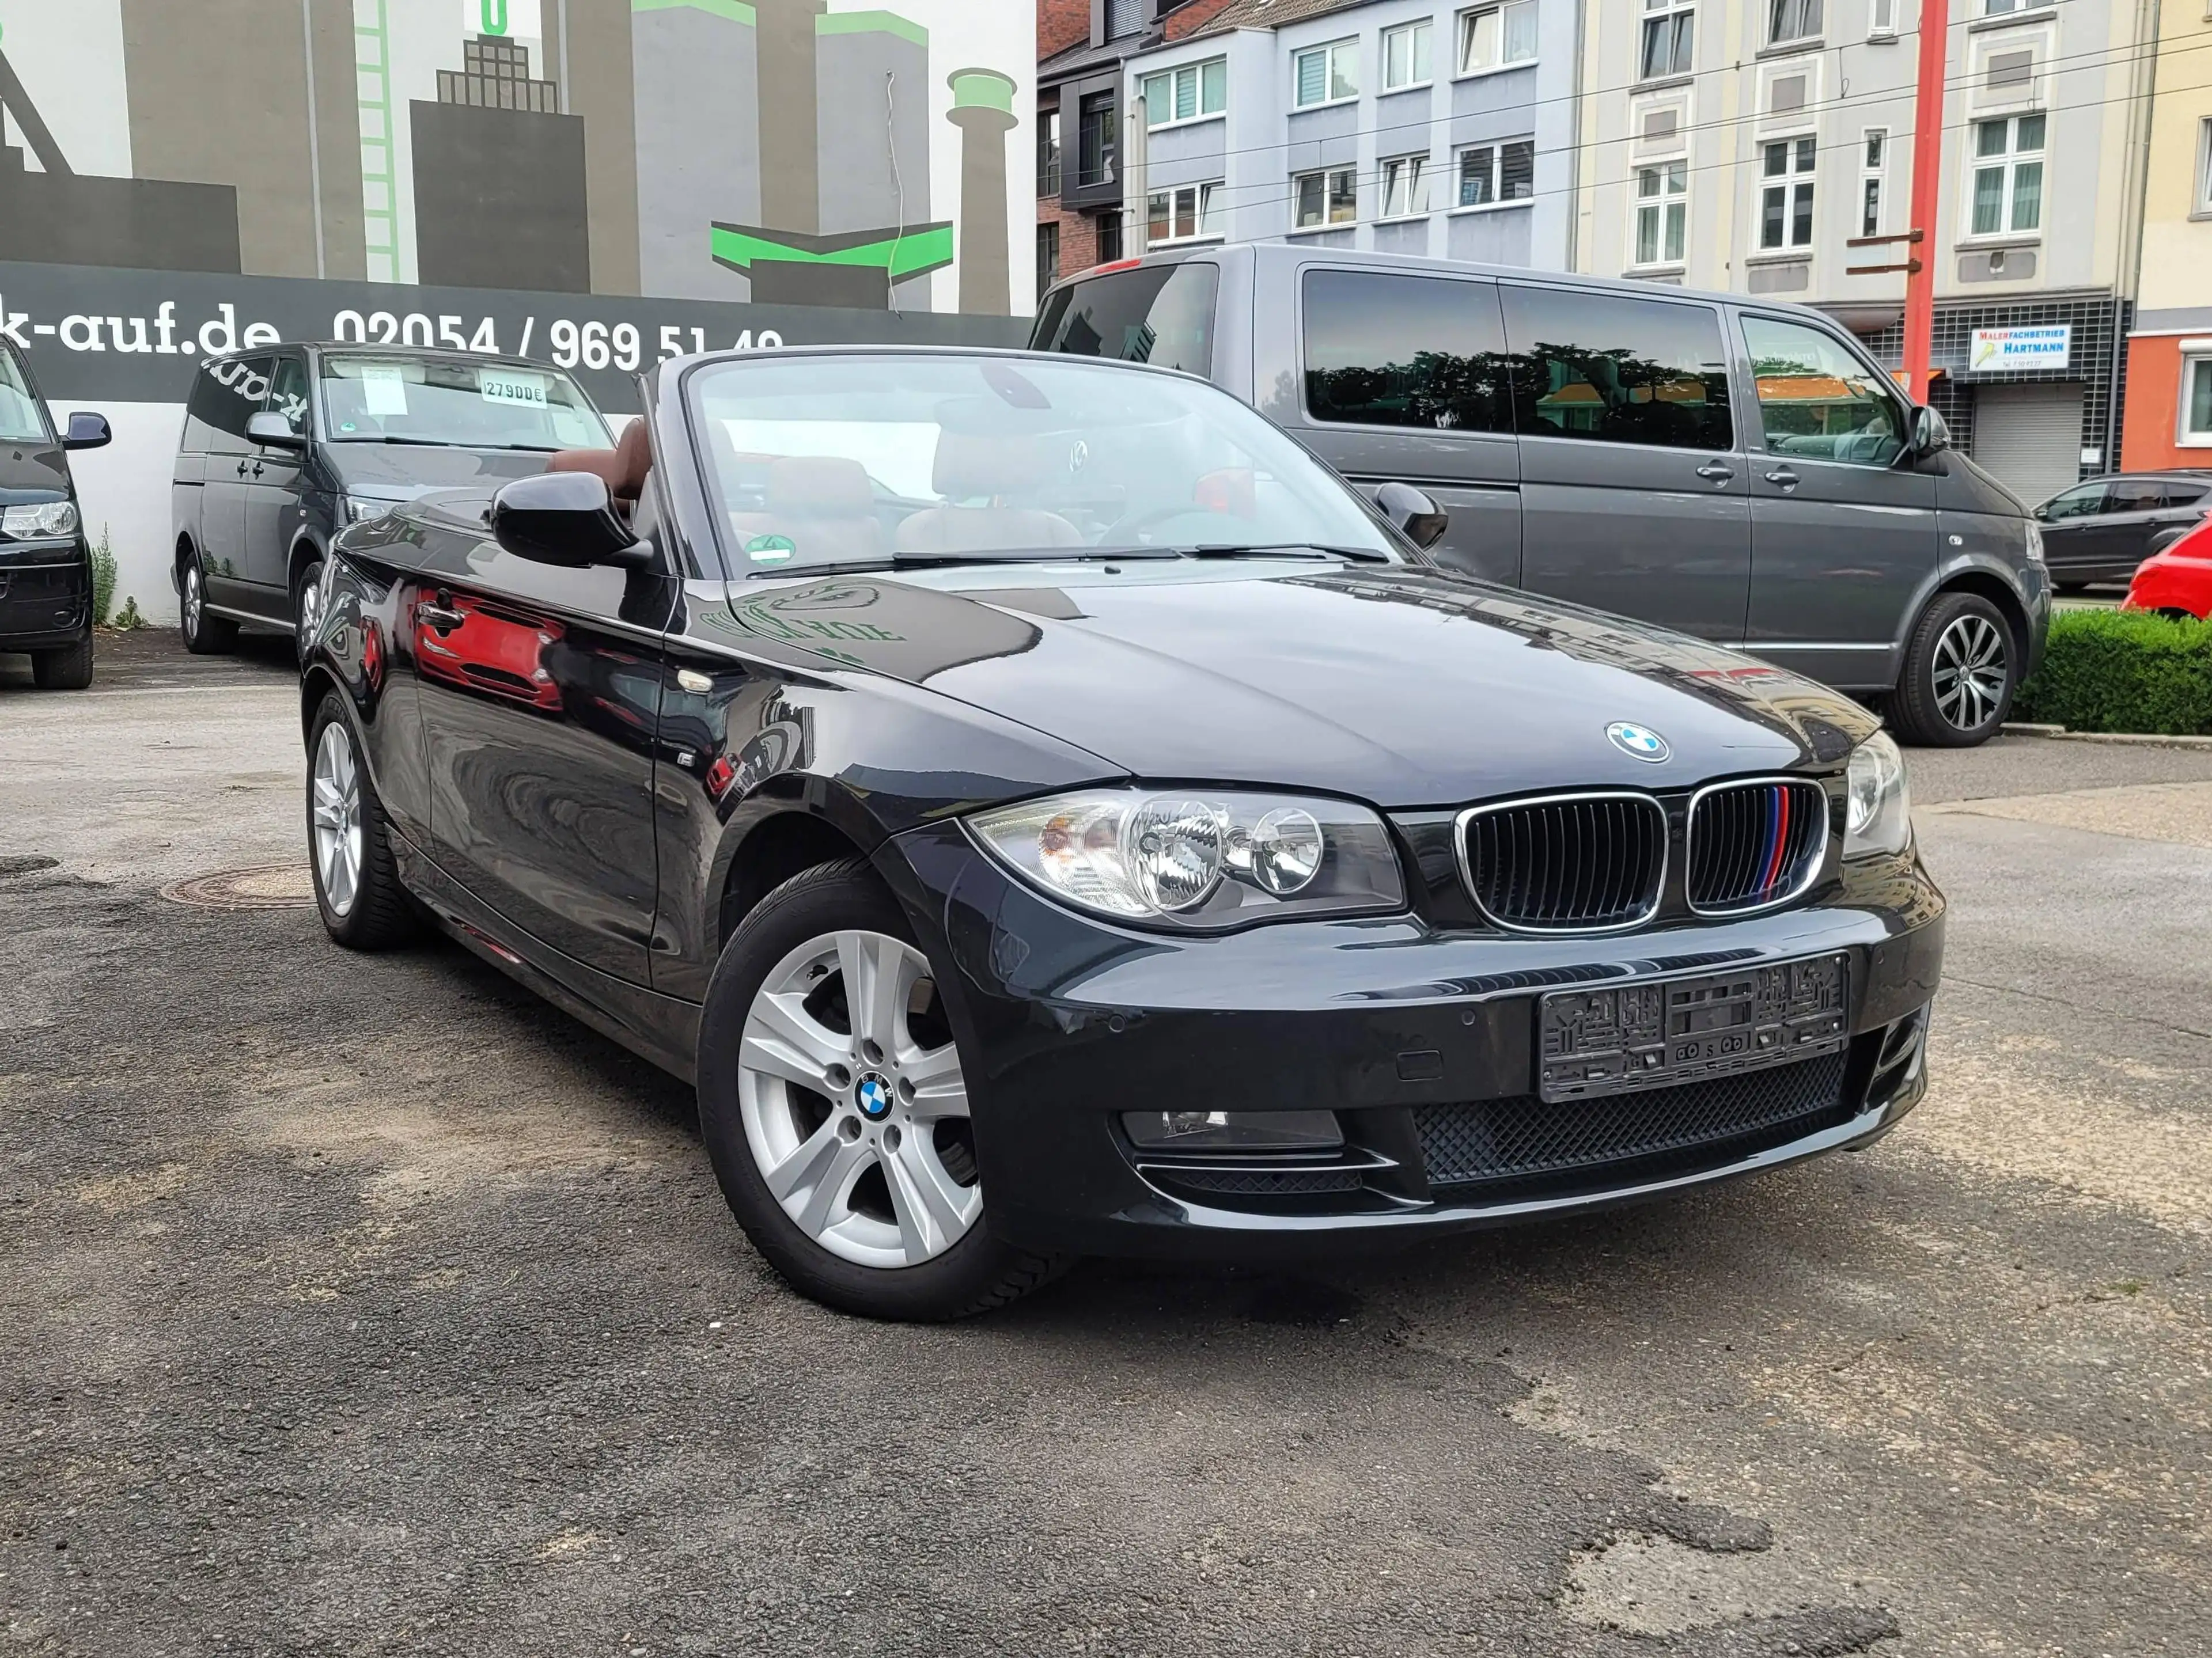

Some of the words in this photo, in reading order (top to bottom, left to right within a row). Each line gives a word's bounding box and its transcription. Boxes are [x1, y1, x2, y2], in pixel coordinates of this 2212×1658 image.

[334, 309, 499, 354] 02054
[550, 319, 640, 371] 969
[1979, 329, 2065, 340] MALERFACHBETRIEB
[2004, 343, 2064, 354] HARTMANN
[487, 382, 542, 402] 27900€
[861, 1075, 893, 1097] BMW
